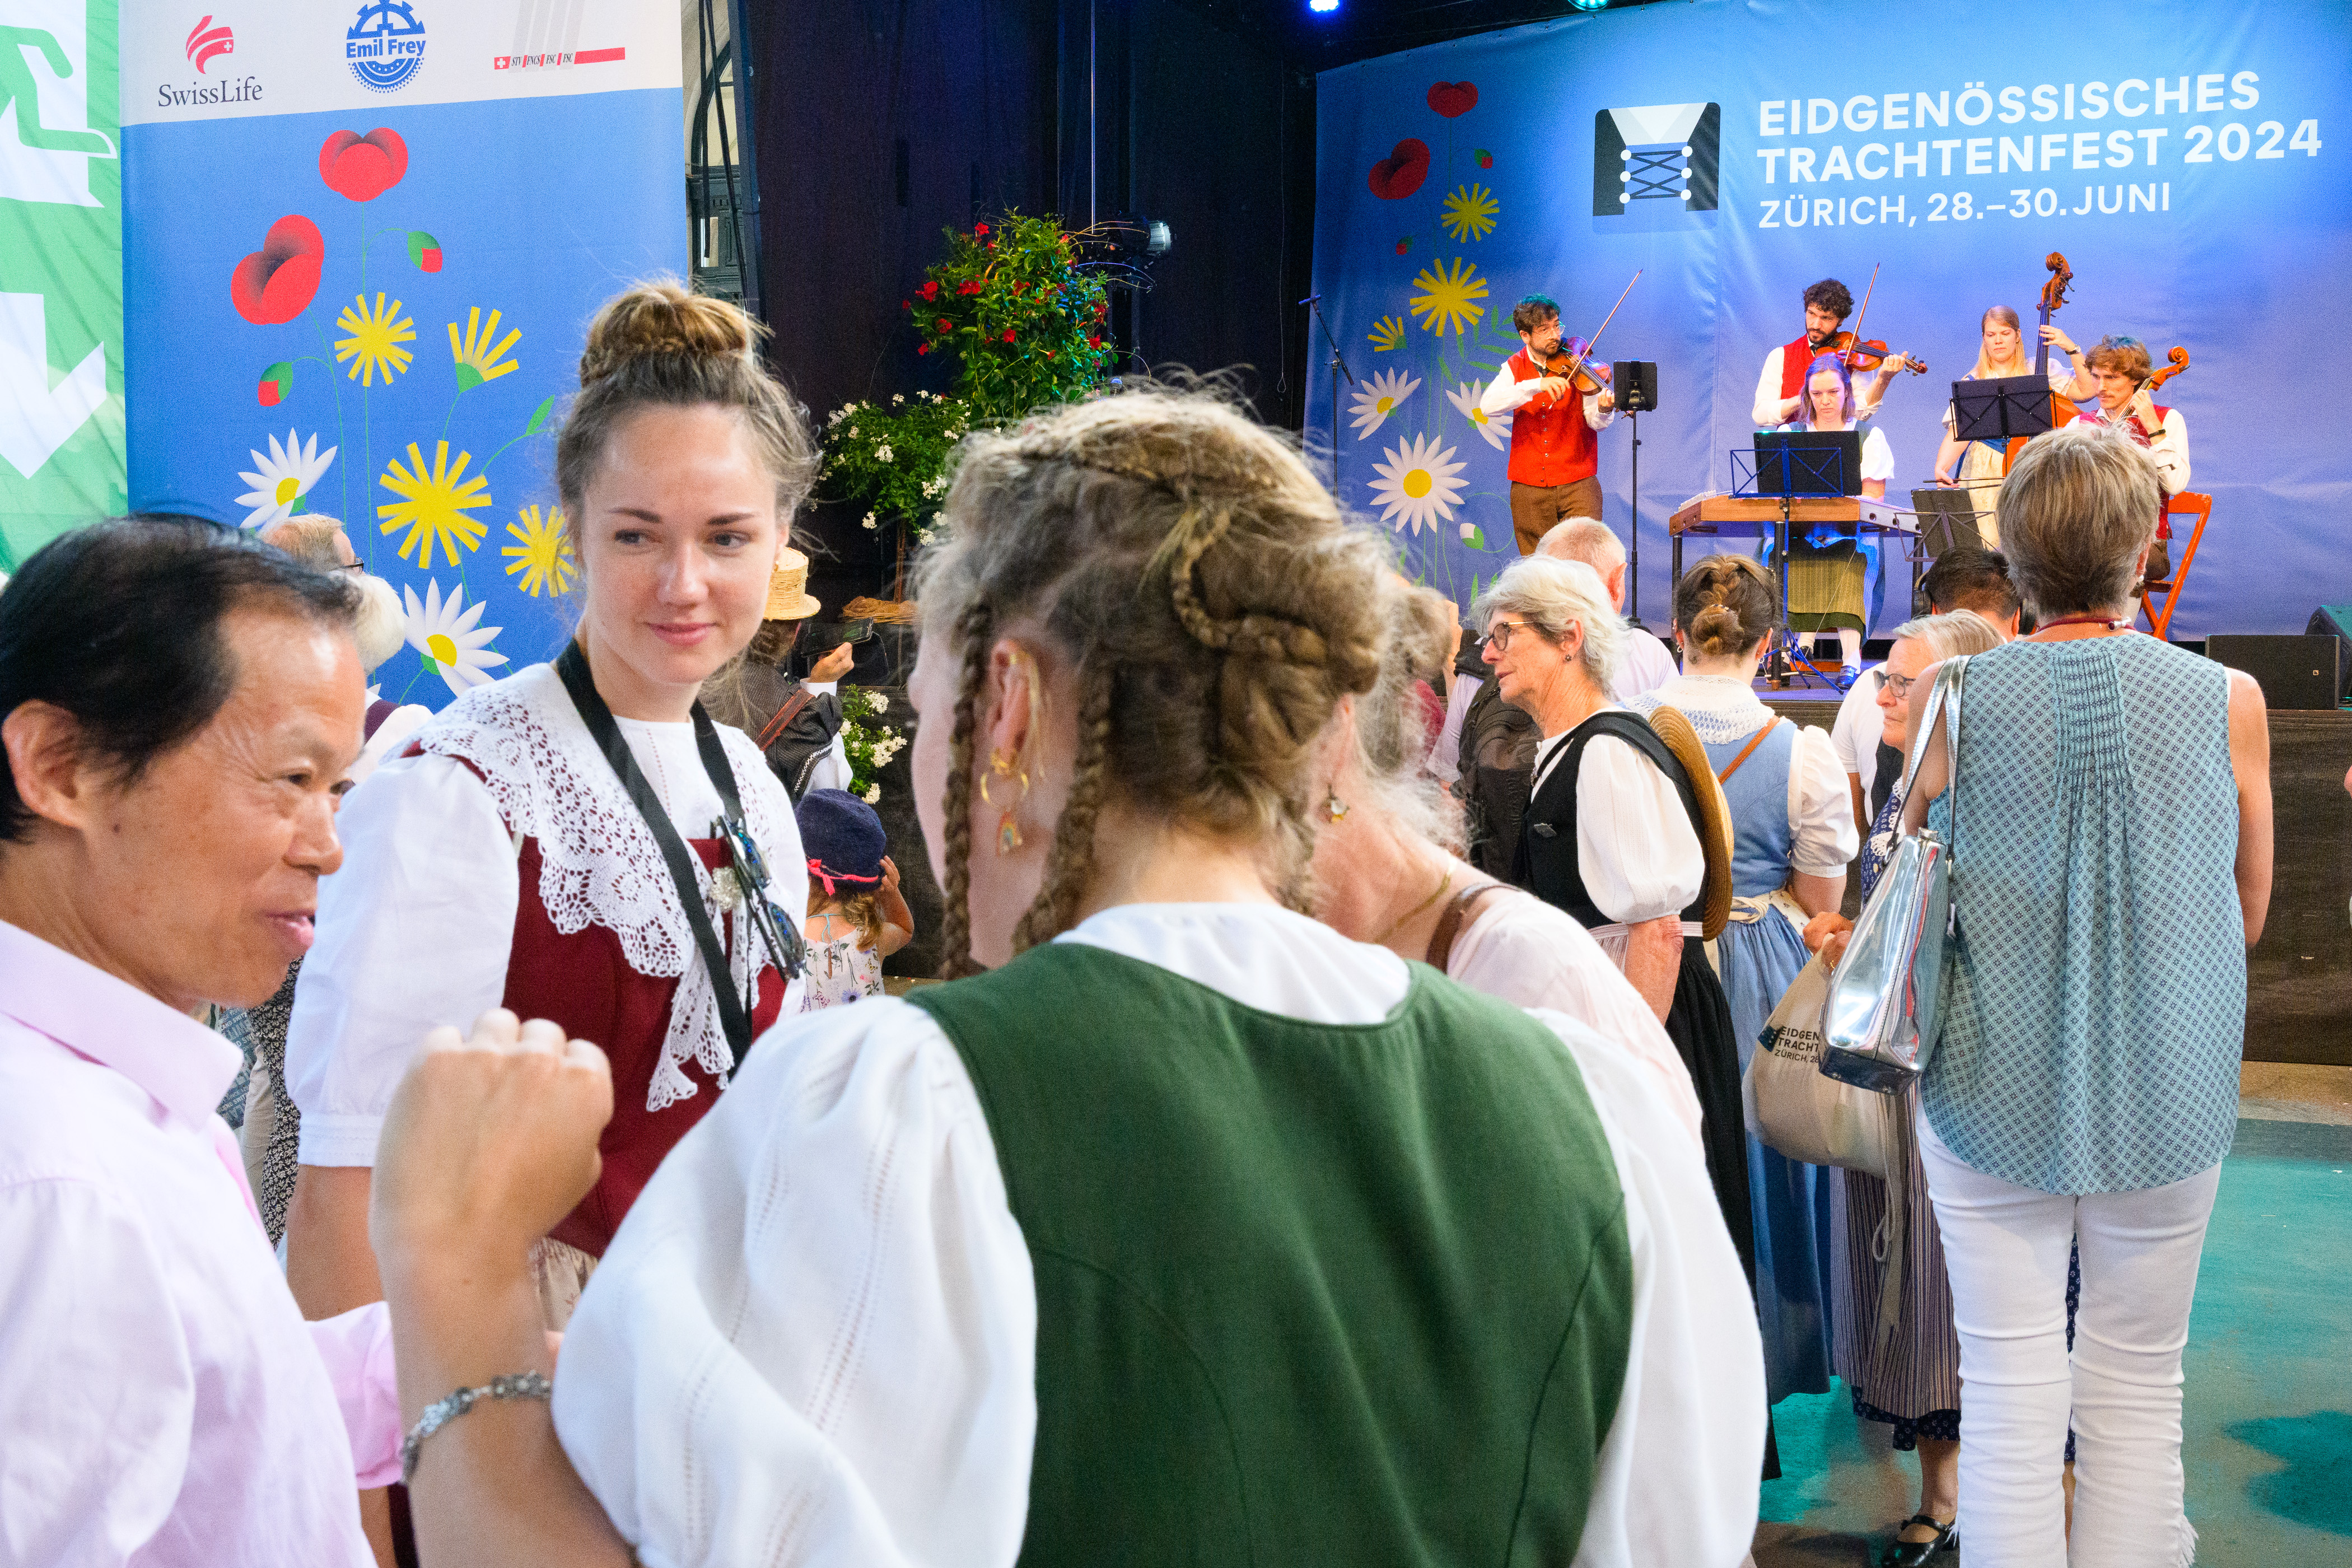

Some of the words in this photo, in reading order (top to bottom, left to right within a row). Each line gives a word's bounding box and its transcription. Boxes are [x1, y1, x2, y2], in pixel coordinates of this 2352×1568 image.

[346, 38, 383, 58] Emil
[388, 38, 427, 57] Frey
[511, 56, 522, 66] STV
[546, 54, 556, 64] FSC
[563, 53, 573, 63] FSC
[1760, 71, 2260, 136] EIDGENÖSSISCHES
[1757, 128, 2168, 184] TRACHTENFEST
[2184, 119, 2322, 164] 2024
[1758, 194, 1917, 228] ZÜRICH,
[1775, 1049, 1808, 1063] ZÜRICH,
